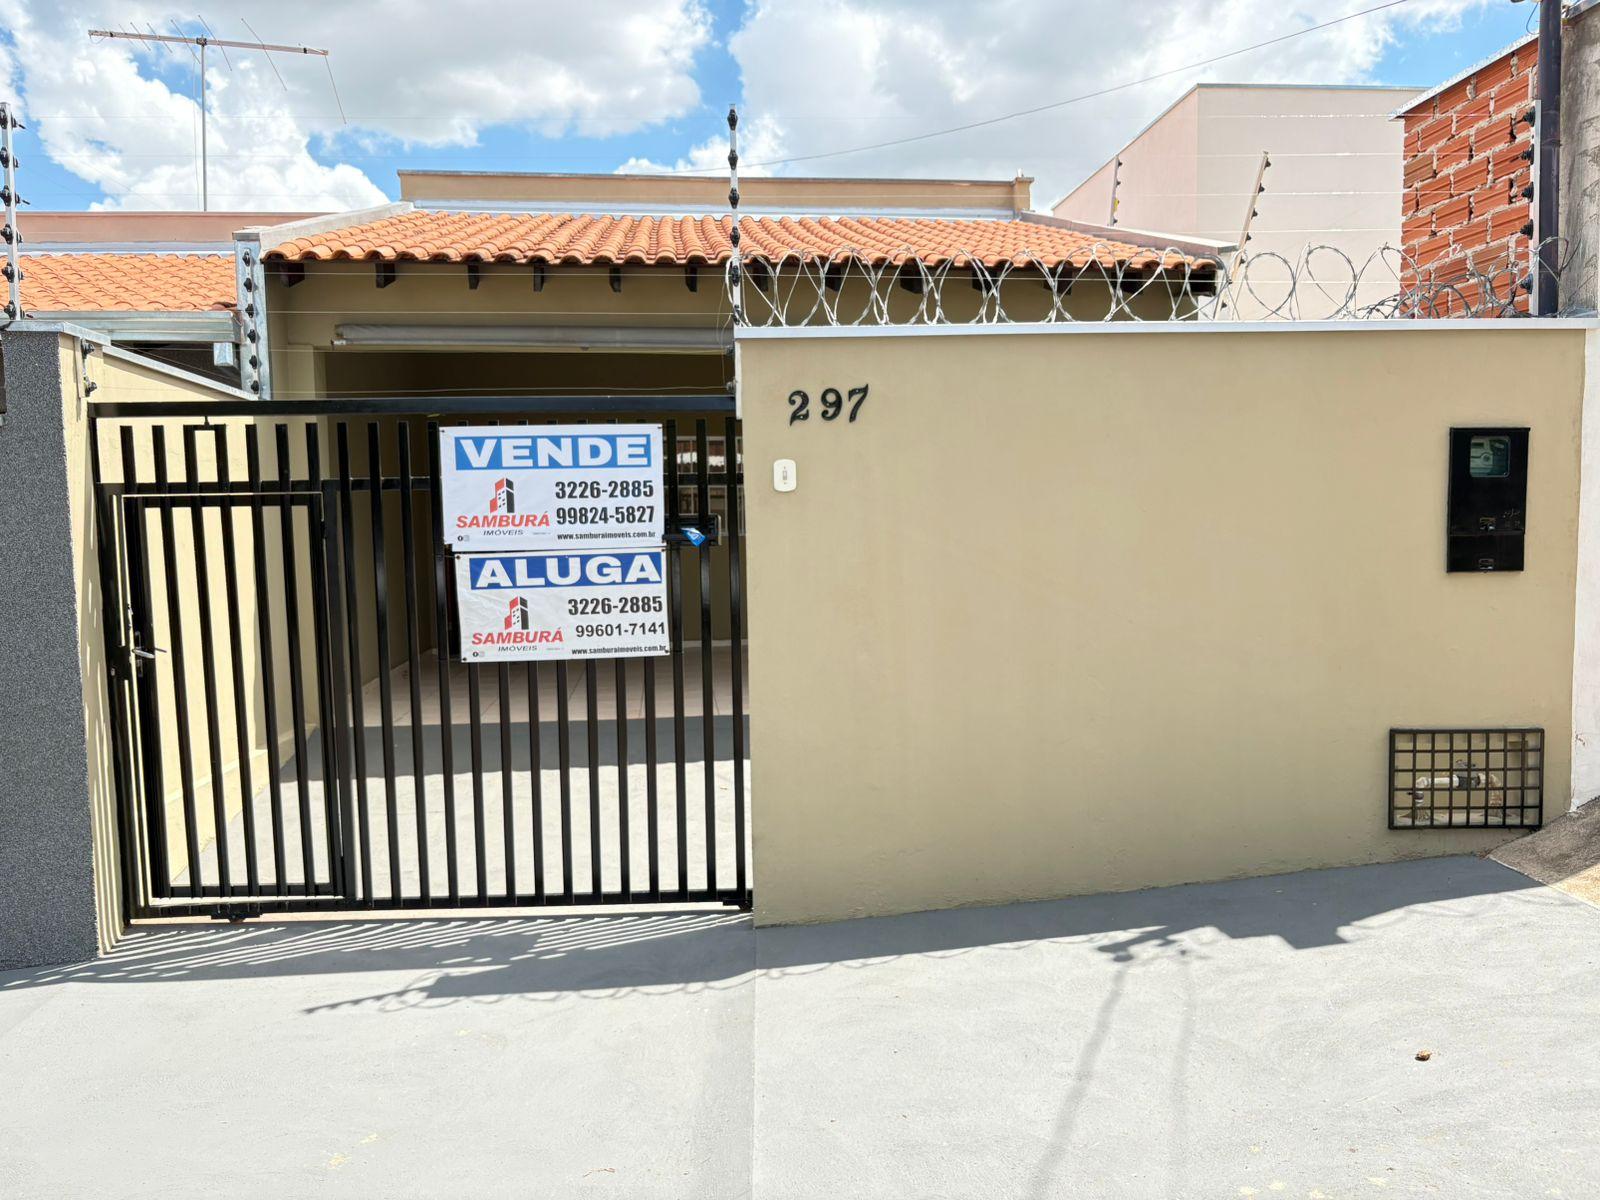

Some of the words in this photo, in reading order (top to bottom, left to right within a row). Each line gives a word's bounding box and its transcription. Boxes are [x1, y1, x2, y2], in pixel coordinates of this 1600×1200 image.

[788, 383, 869, 426] 297
[460, 436, 649, 468] VENDE
[555, 480, 654, 499] 3226-2885
[456, 510, 550, 528] SAMBURÁ
[556, 505, 655, 525] 99824-5827
[483, 528, 524, 536] IMÓVEIS
[557, 531, 656, 541] www.samburaimoveis.com.br
[476, 554, 662, 588] ALUGA
[567, 596, 663, 616] 3226-2885
[471, 627, 564, 645] SAMBURÁ
[575, 621, 666, 638] 99601-7141
[571, 644, 667, 655] www.samburaimoveis.com.br
